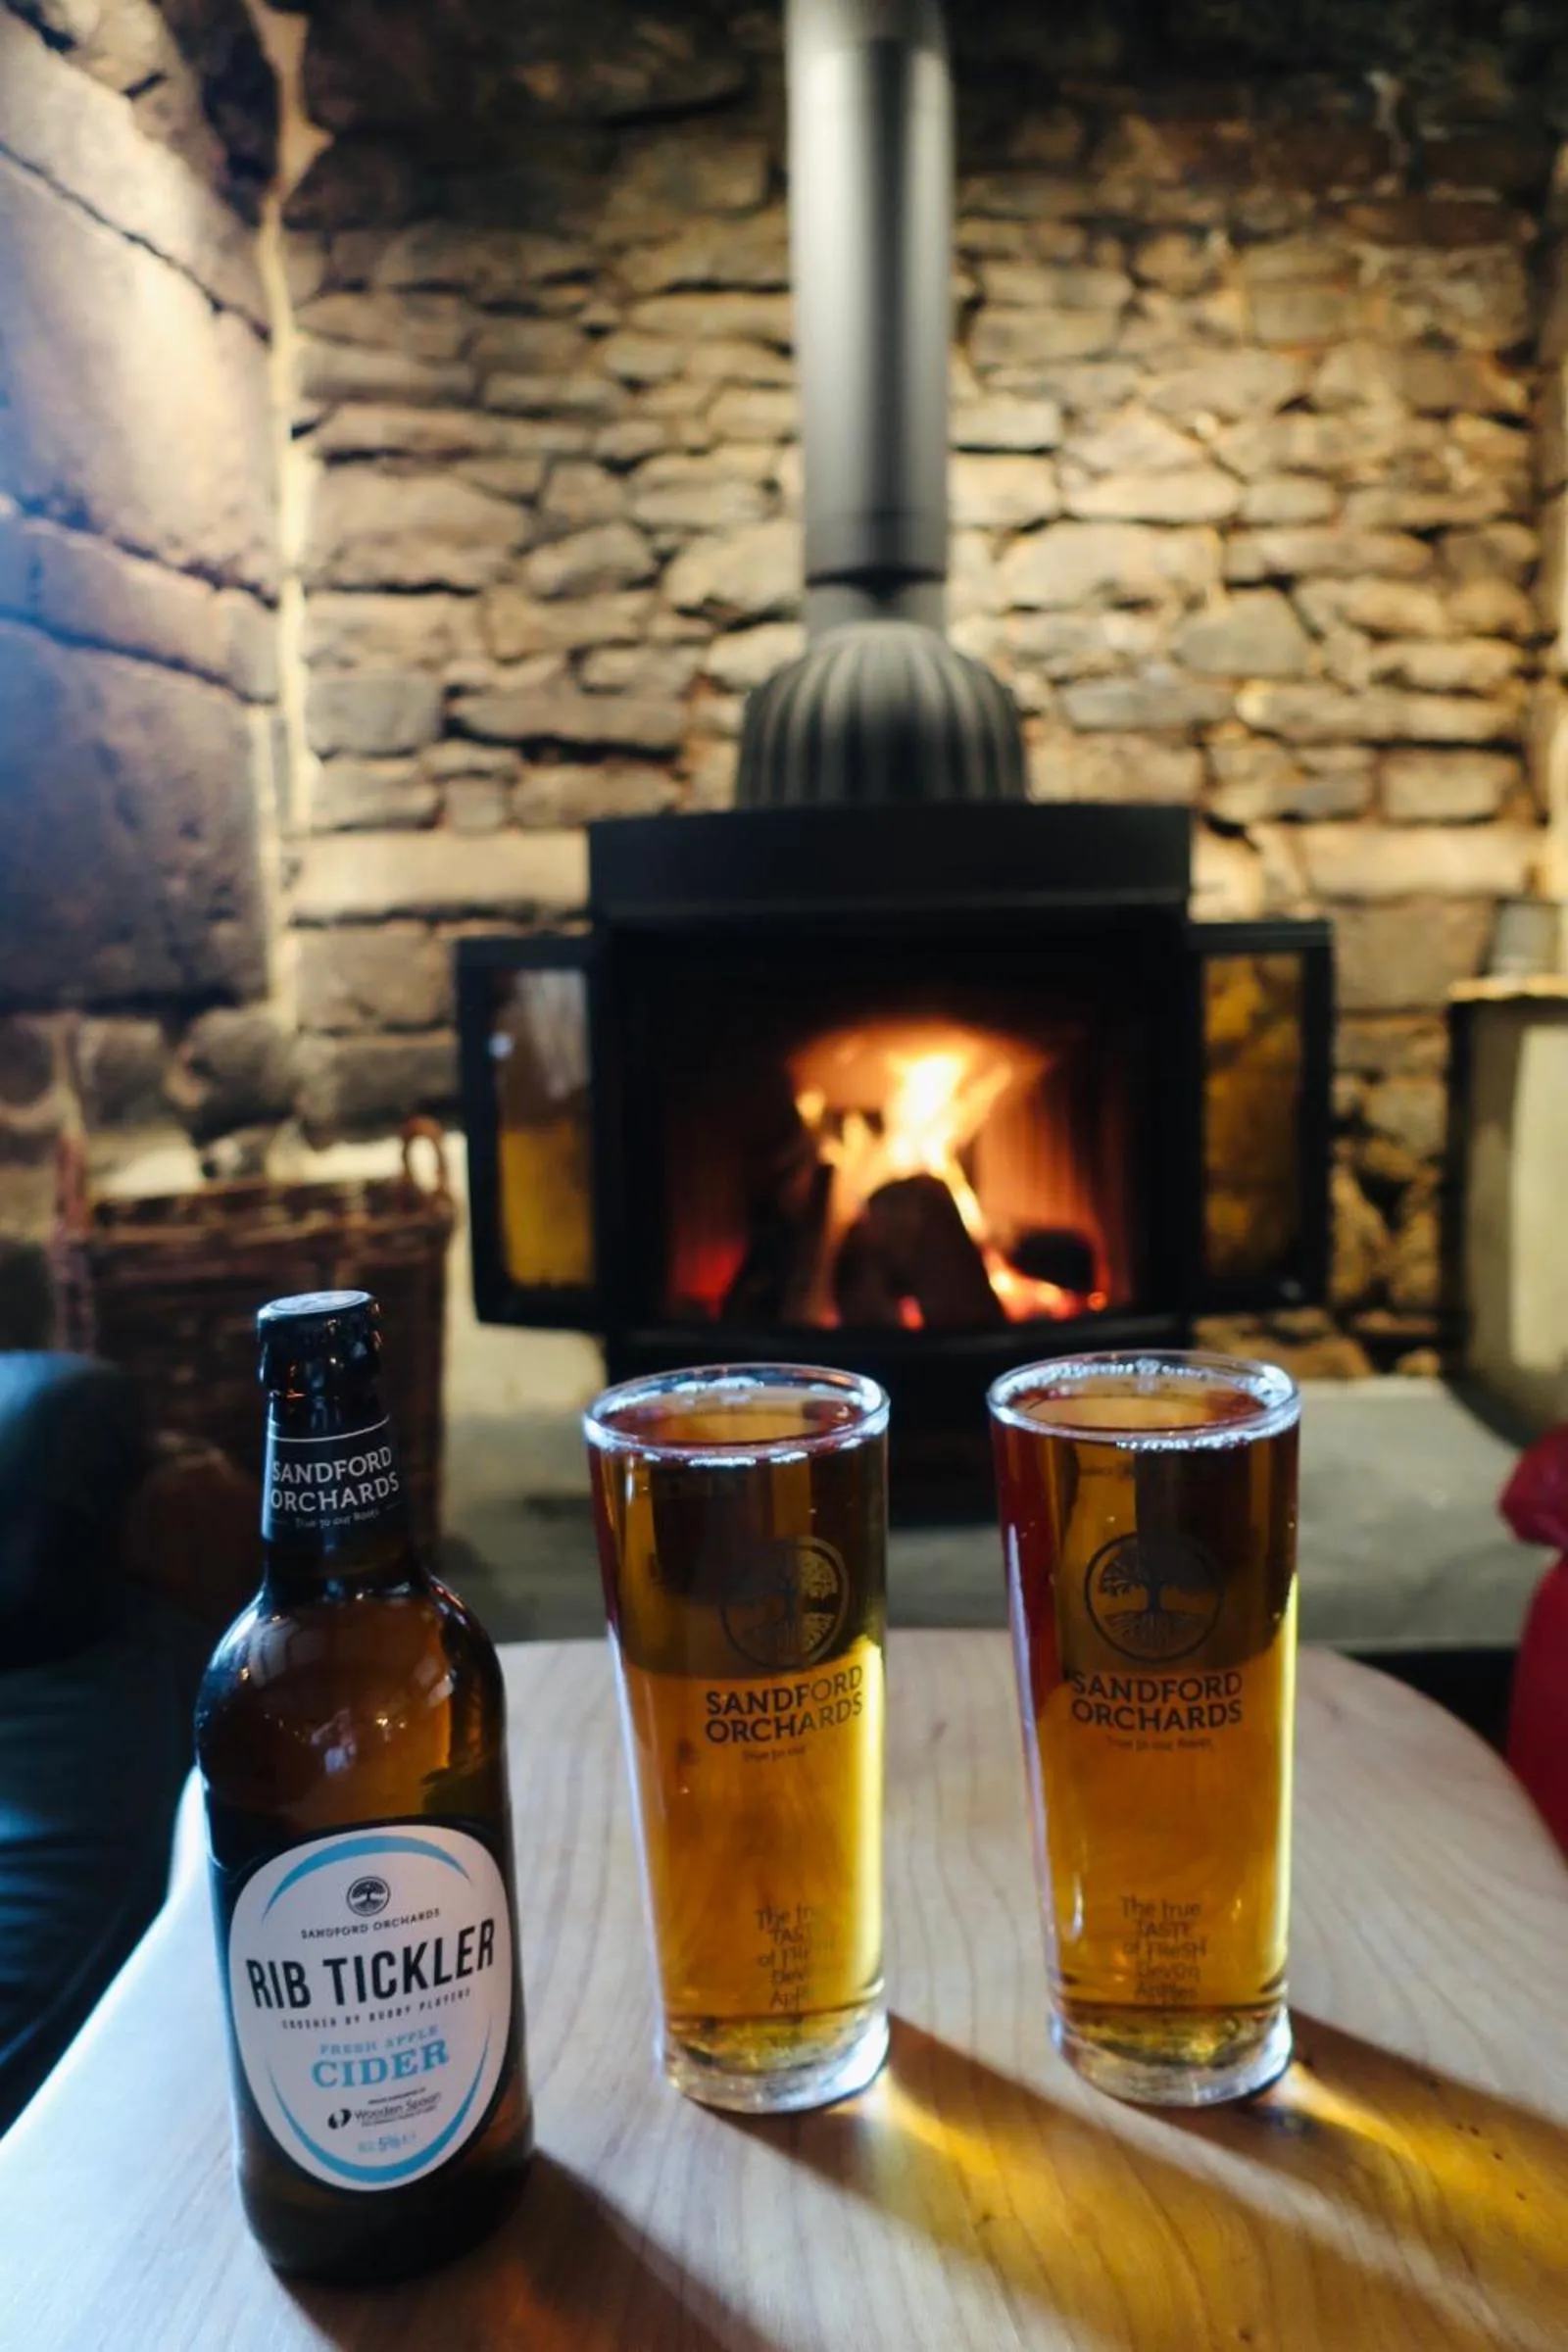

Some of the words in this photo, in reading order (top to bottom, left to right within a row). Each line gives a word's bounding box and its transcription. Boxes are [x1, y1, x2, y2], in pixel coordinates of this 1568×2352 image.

[271, 1446, 392, 1485] SANDFORD
[270, 1472, 399, 1512] ORCHARDS
[706, 1665, 863, 1715] SANDFORD
[1072, 1669, 1242, 1703] SANDFORD
[706, 1691, 863, 1742] ORCHARDS
[1071, 1698, 1242, 1732] ORCHARDS
[301, 1923, 368, 1939] SANDFORD
[373, 1908, 440, 1932] ORCHARDS
[246, 1958, 312, 2010] RIB
[322, 1918, 495, 2007] TICKLER
[345, 2015, 361, 2026] BY
[419, 1987, 470, 2011] PLAYERS
[319, 2040, 377, 2056] FRESH
[385, 2024, 439, 2048] APPLE
[311, 2038, 451, 2089] CIDER
